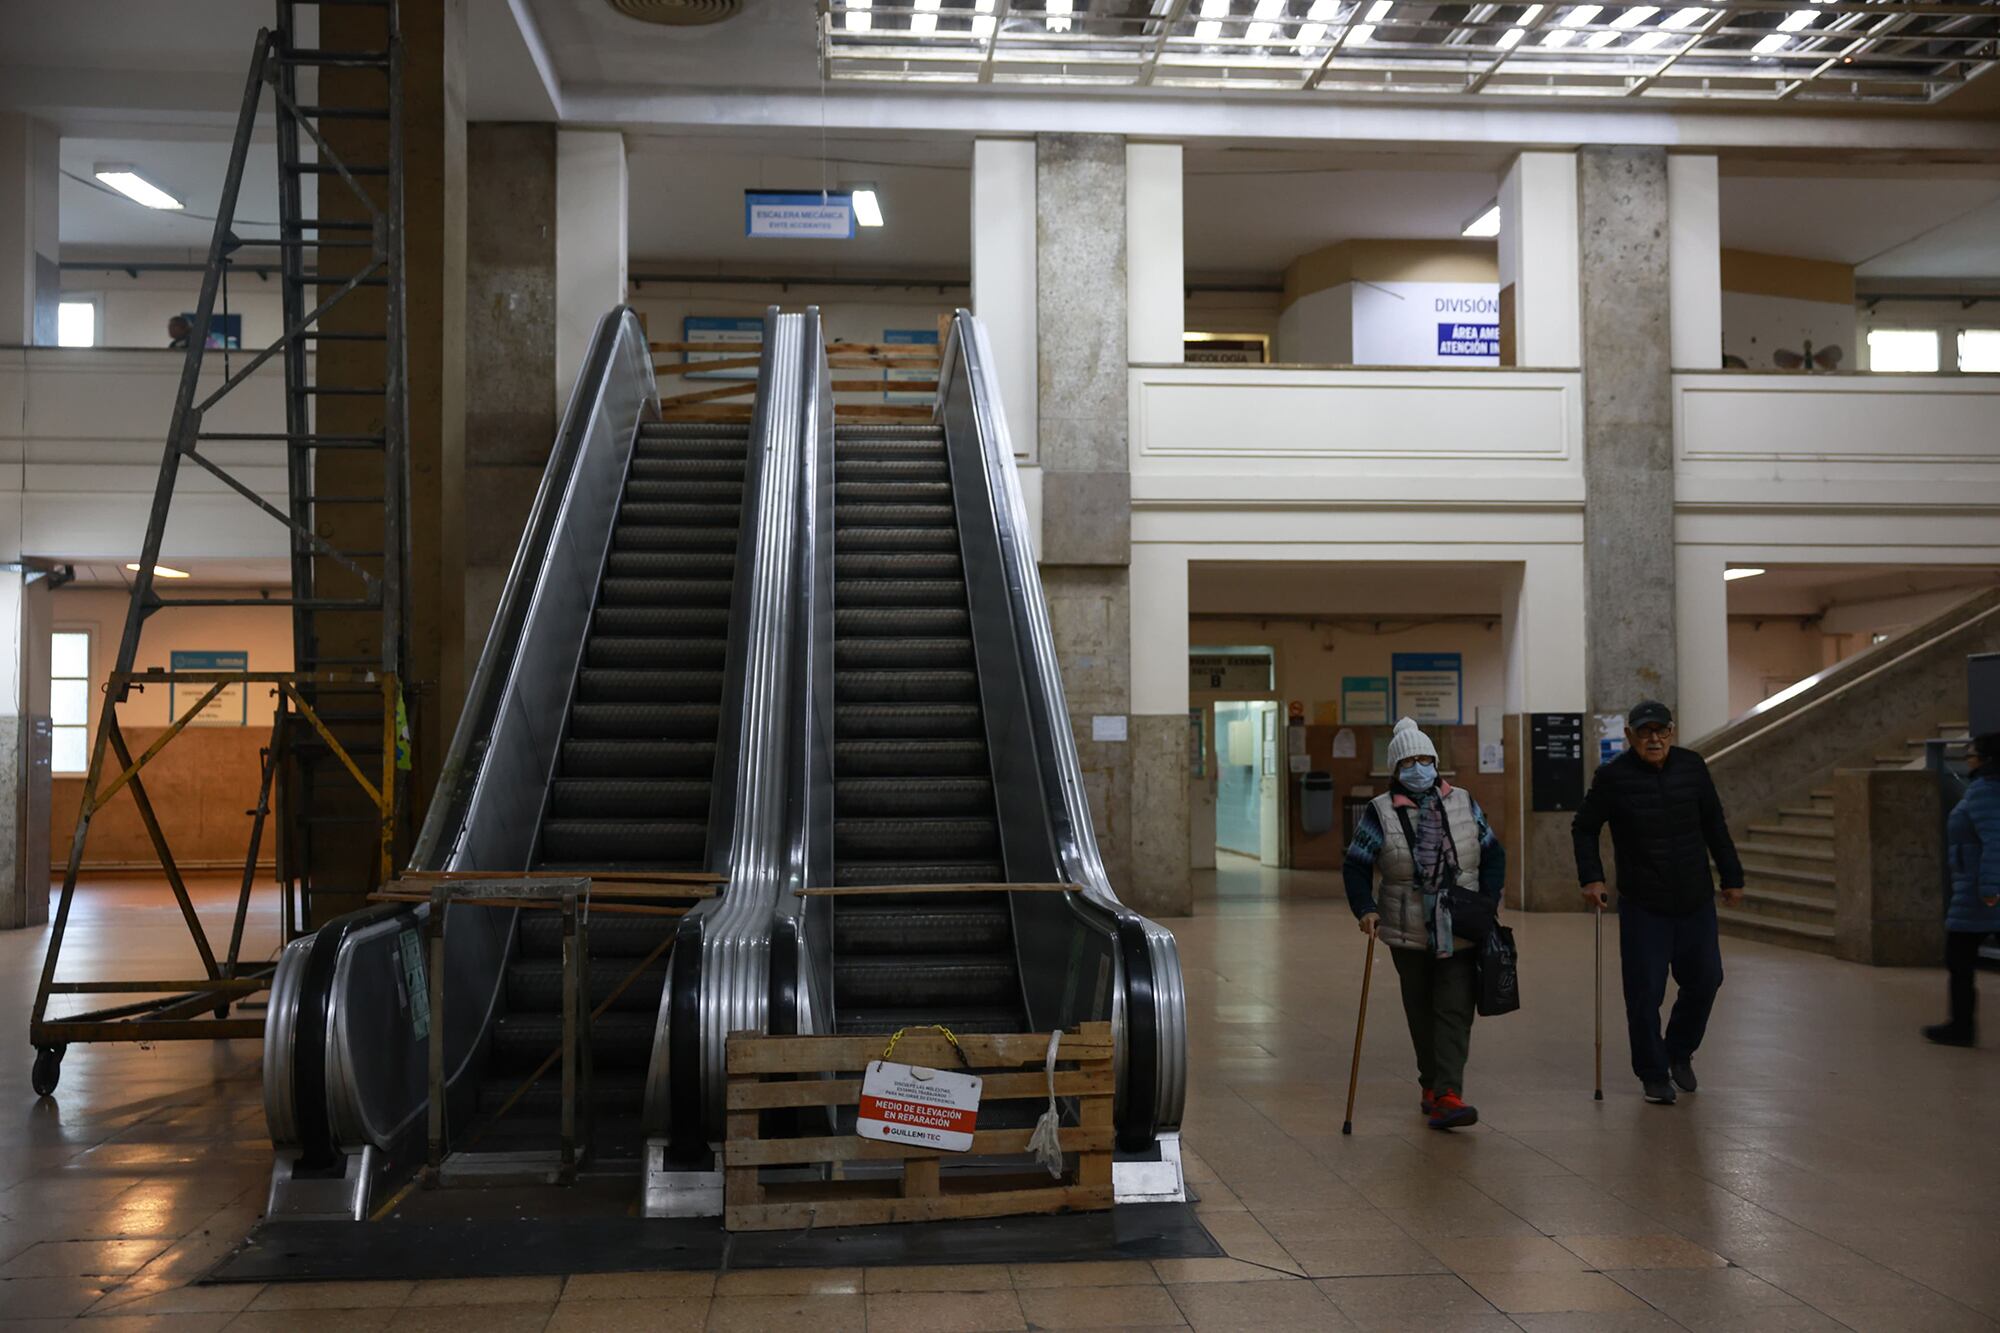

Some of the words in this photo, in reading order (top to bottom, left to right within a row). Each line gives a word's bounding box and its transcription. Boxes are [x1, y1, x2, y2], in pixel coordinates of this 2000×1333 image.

[757, 210, 799, 219] ESCALERA
[801, 208, 844, 219] MECÁNICA
[1435, 297, 1499, 313] DIVISIÓN
[1451, 323, 1478, 341] ÁREA
[1440, 338, 1489, 355] ATENCIÓN
[1211, 674, 1221, 688] B
[875, 1100, 903, 1111] MEDIO
[916, 1106, 962, 1120] ELEVACIÓN
[884, 1111, 896, 1119] EN
[897, 1112, 950, 1128] REPARACIÓN
[891, 1128, 926, 1139] GUILLEMI
[927, 1133, 941, 1141] TEC
